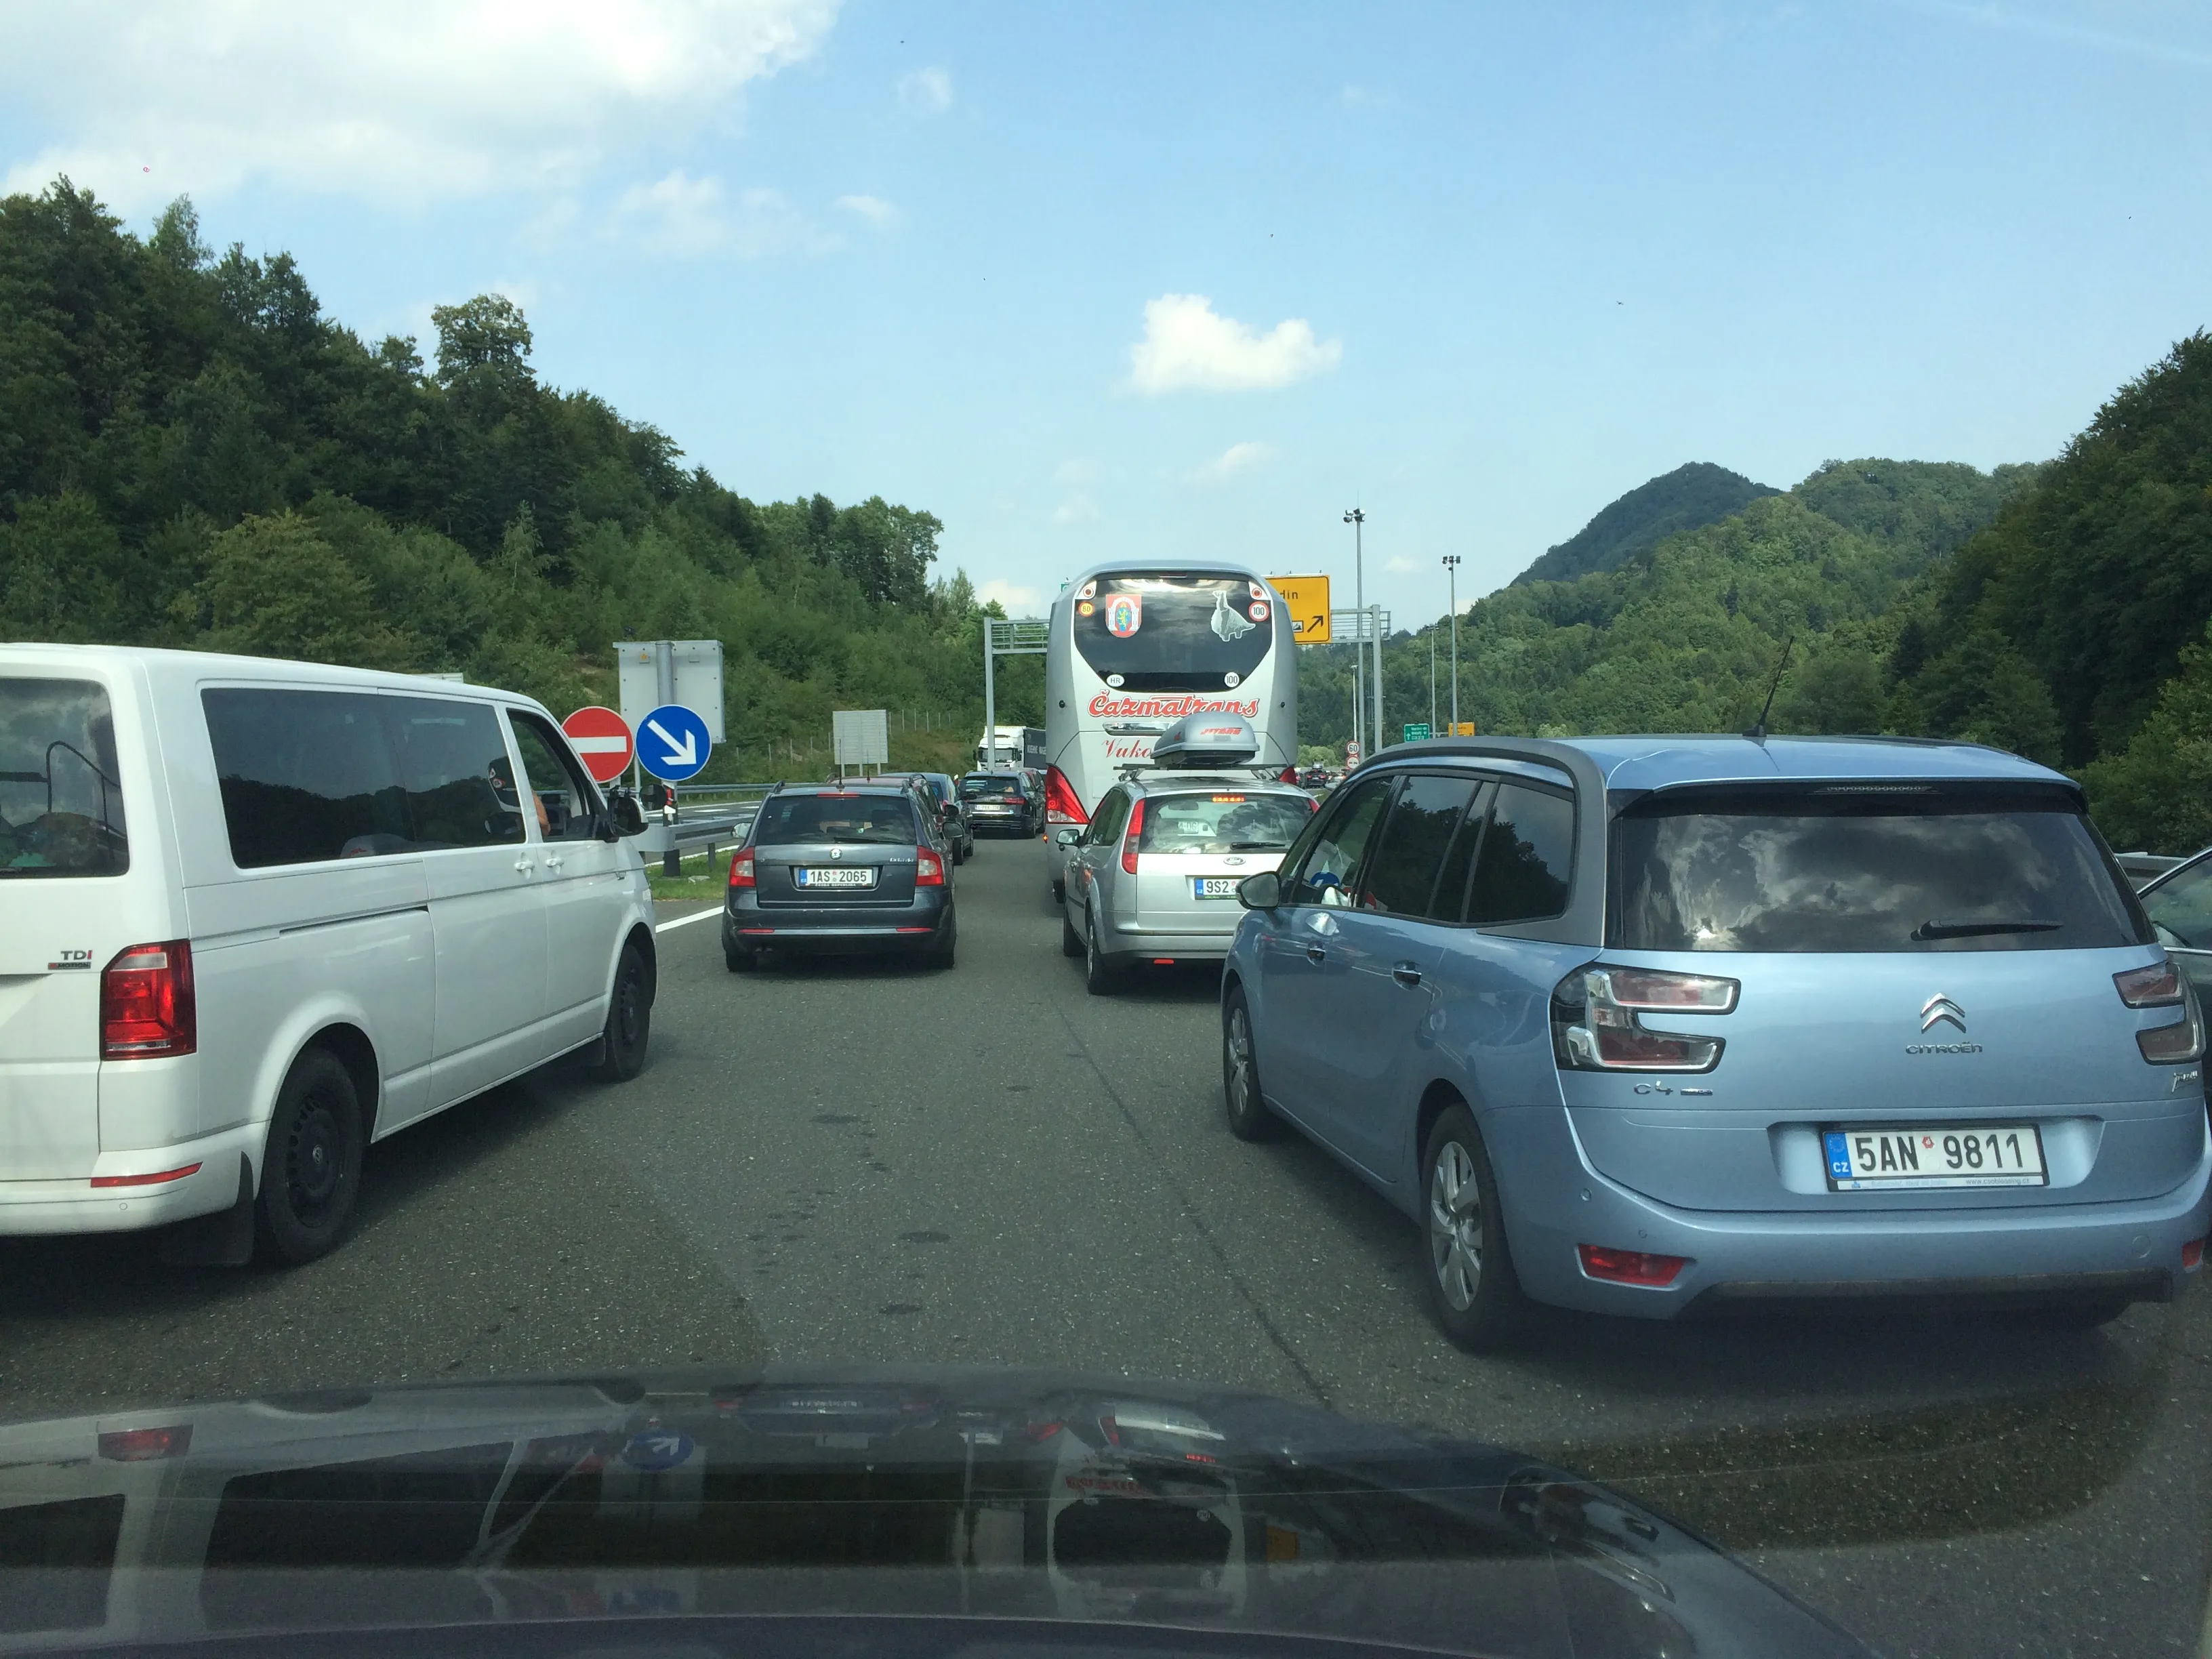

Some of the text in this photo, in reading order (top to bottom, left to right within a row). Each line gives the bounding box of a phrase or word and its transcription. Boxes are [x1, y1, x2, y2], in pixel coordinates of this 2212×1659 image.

[1253, 607, 1265, 616] 100
[1226, 676, 1238, 684] 100
[811, 871, 830, 882] 1AS
[839, 871, 867, 882] 2065
[1206, 881, 1229, 893] 9S2
[60, 950, 93, 960] TDI
[1634, 1080, 1673, 1095] C4
[1832, 1133, 2023, 1172] CZ 5AN 9811
